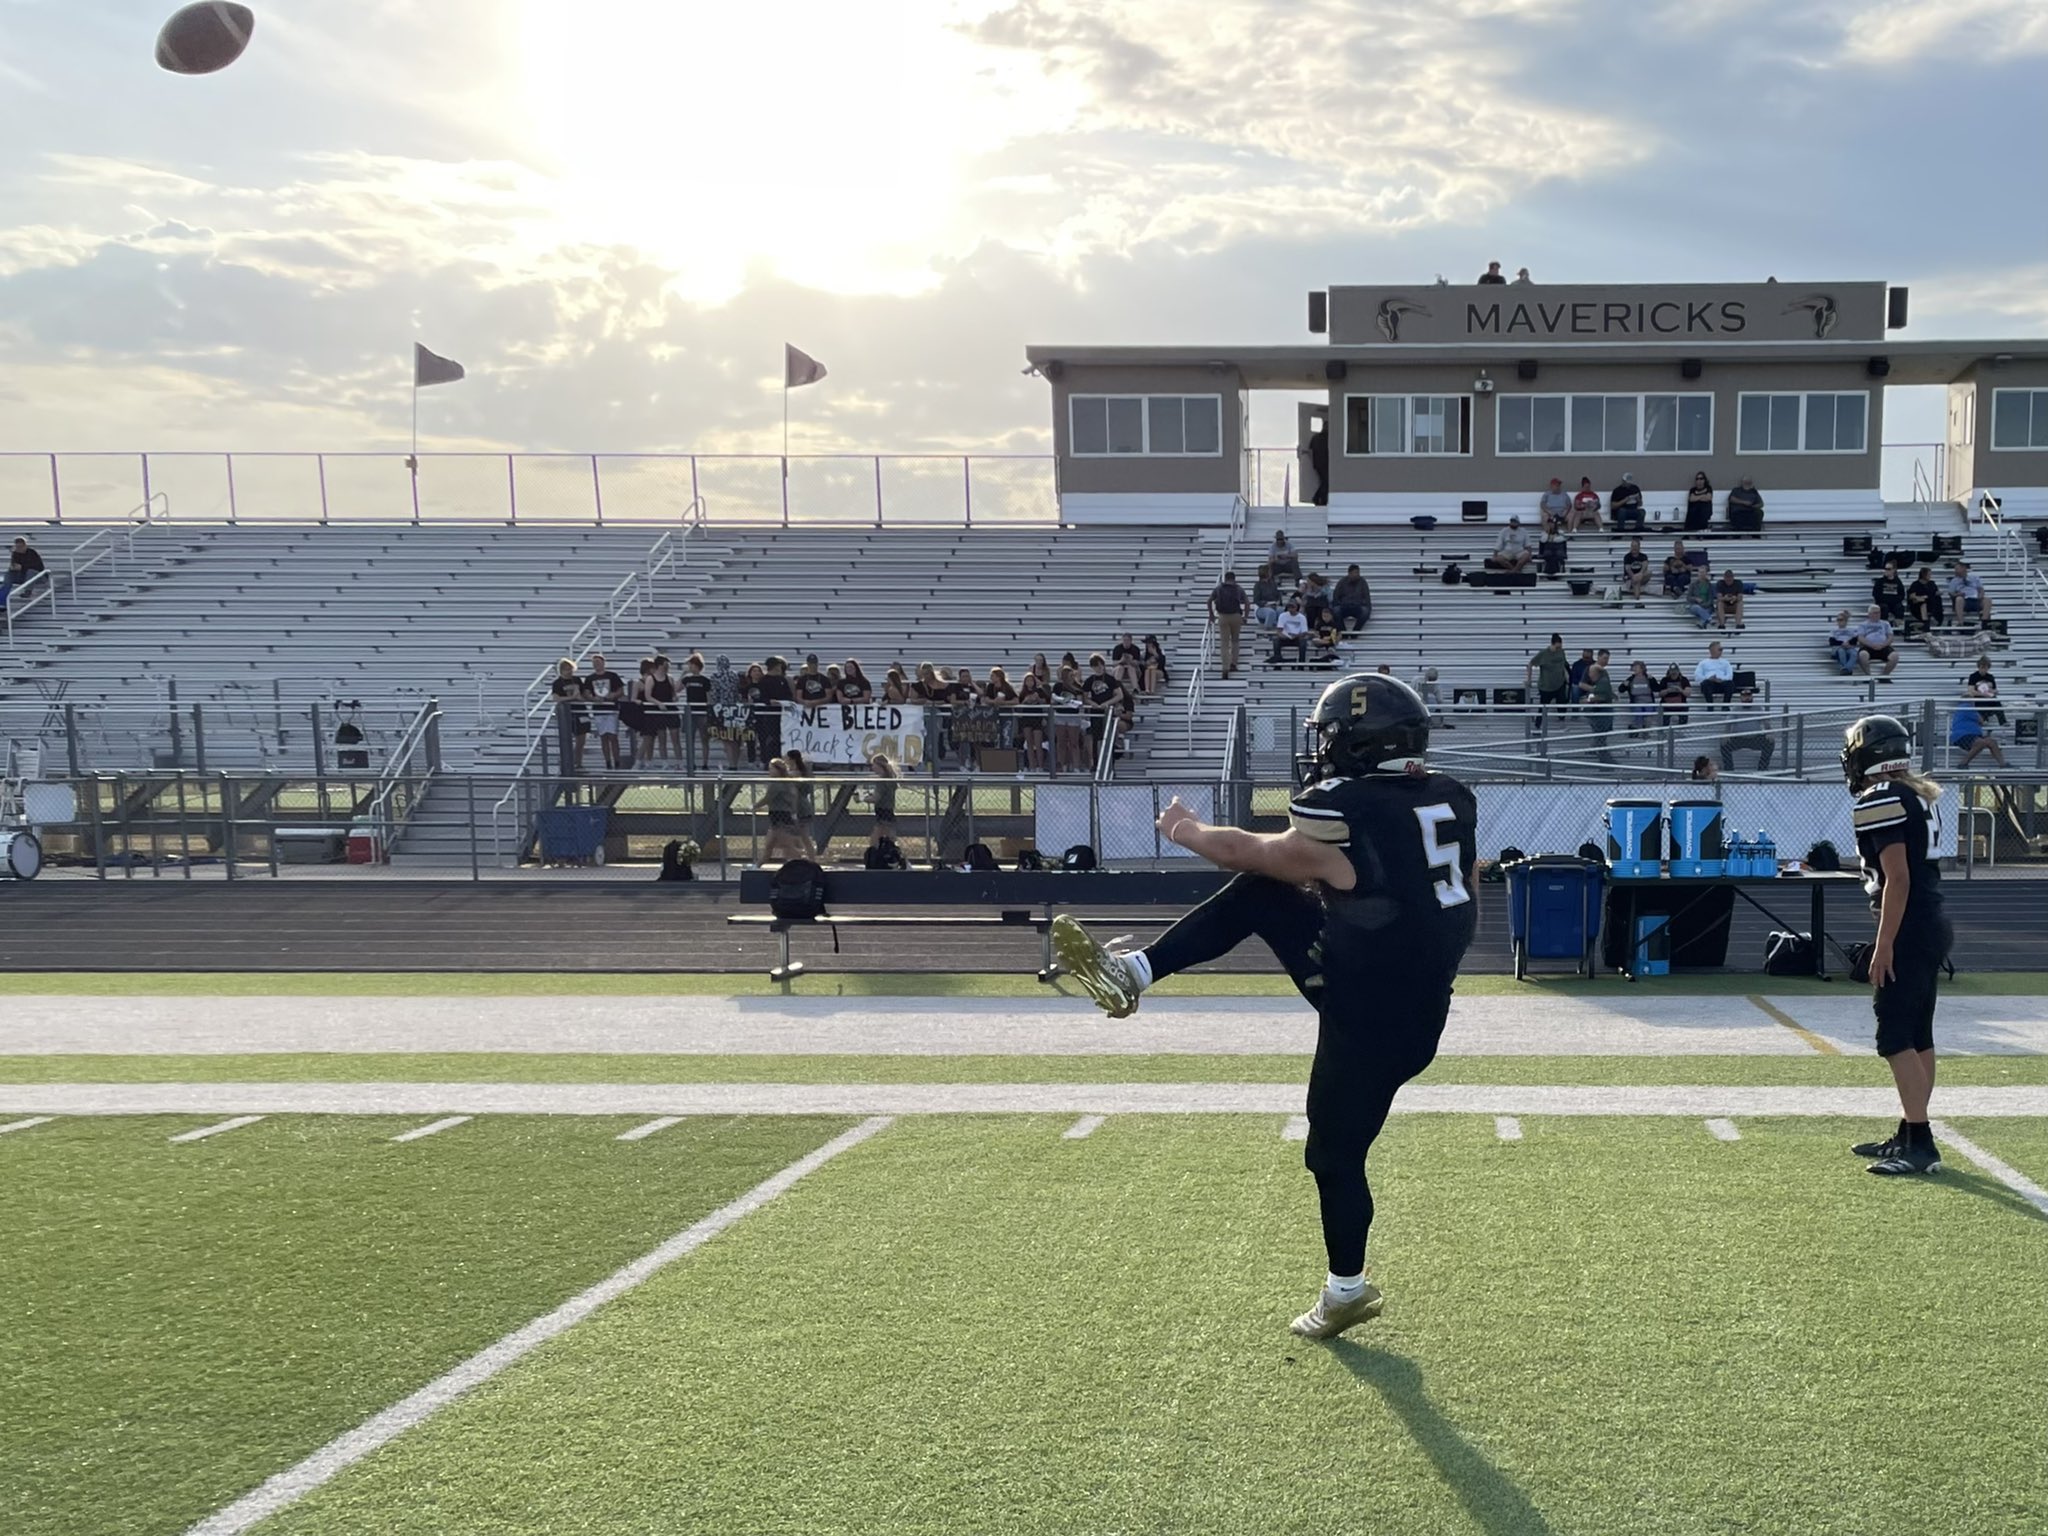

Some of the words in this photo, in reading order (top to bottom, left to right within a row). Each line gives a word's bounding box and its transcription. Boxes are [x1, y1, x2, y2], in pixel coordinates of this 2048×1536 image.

[1466, 302, 1746, 333] MAVERICKS
[1351, 686, 1367, 716] 5
[800, 706, 830, 728] WE
[841, 705, 902, 731] BLEED
[788, 729, 840, 760] Black
[1413, 803, 1470, 909] 5
[1096, 951, 1131, 987] adidas
